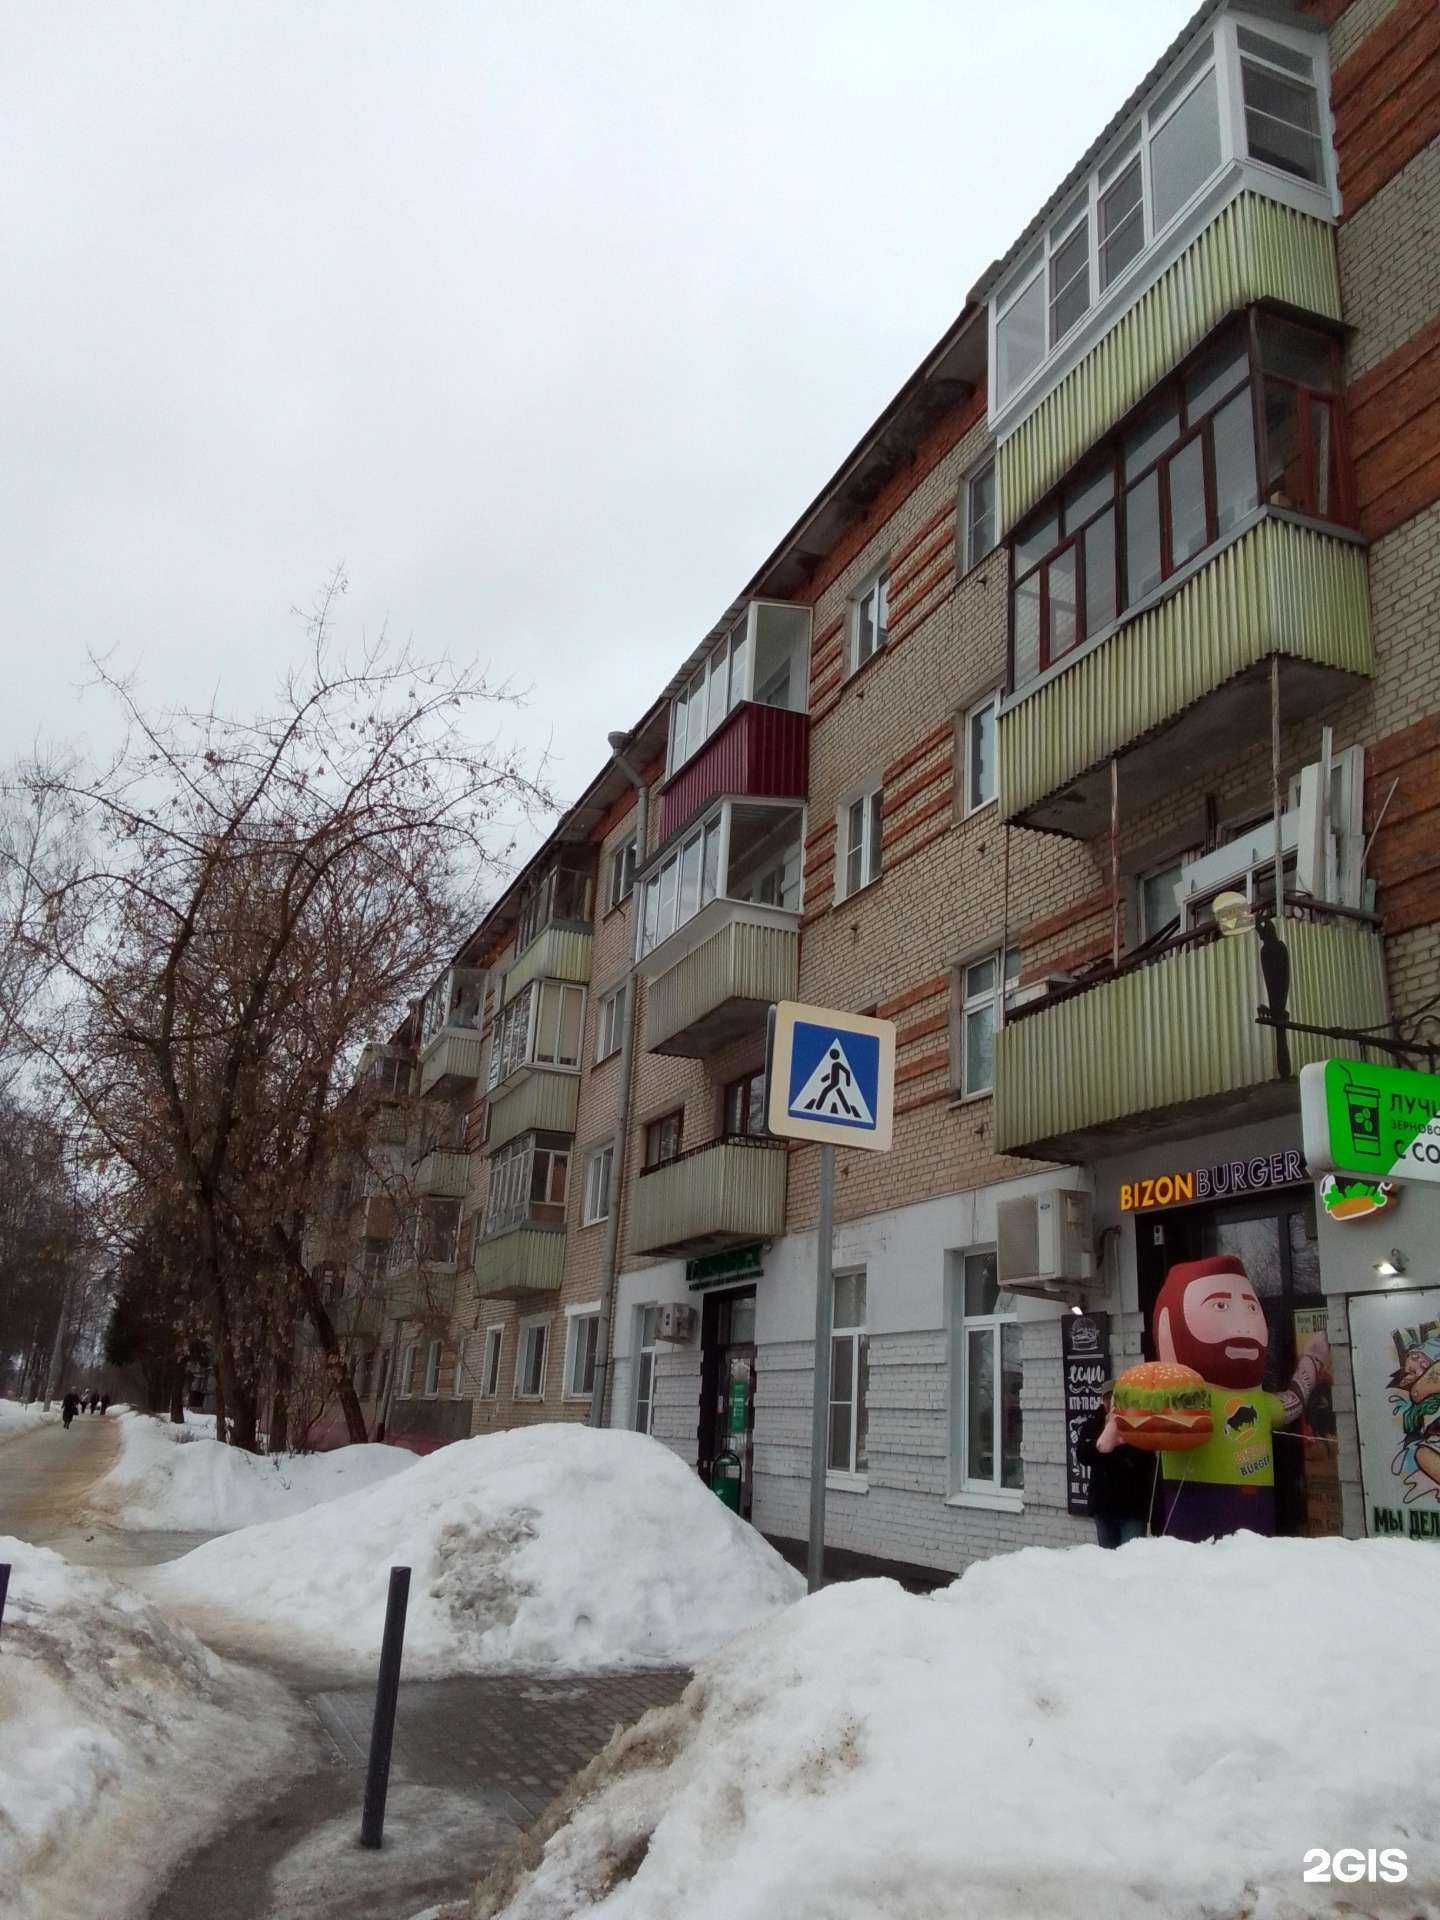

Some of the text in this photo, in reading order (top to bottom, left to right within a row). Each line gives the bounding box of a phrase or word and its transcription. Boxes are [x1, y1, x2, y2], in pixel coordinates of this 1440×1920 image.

[1394, 1139, 1406, 1159] С
[1120, 1150, 1303, 1211] BIZON BURGER
